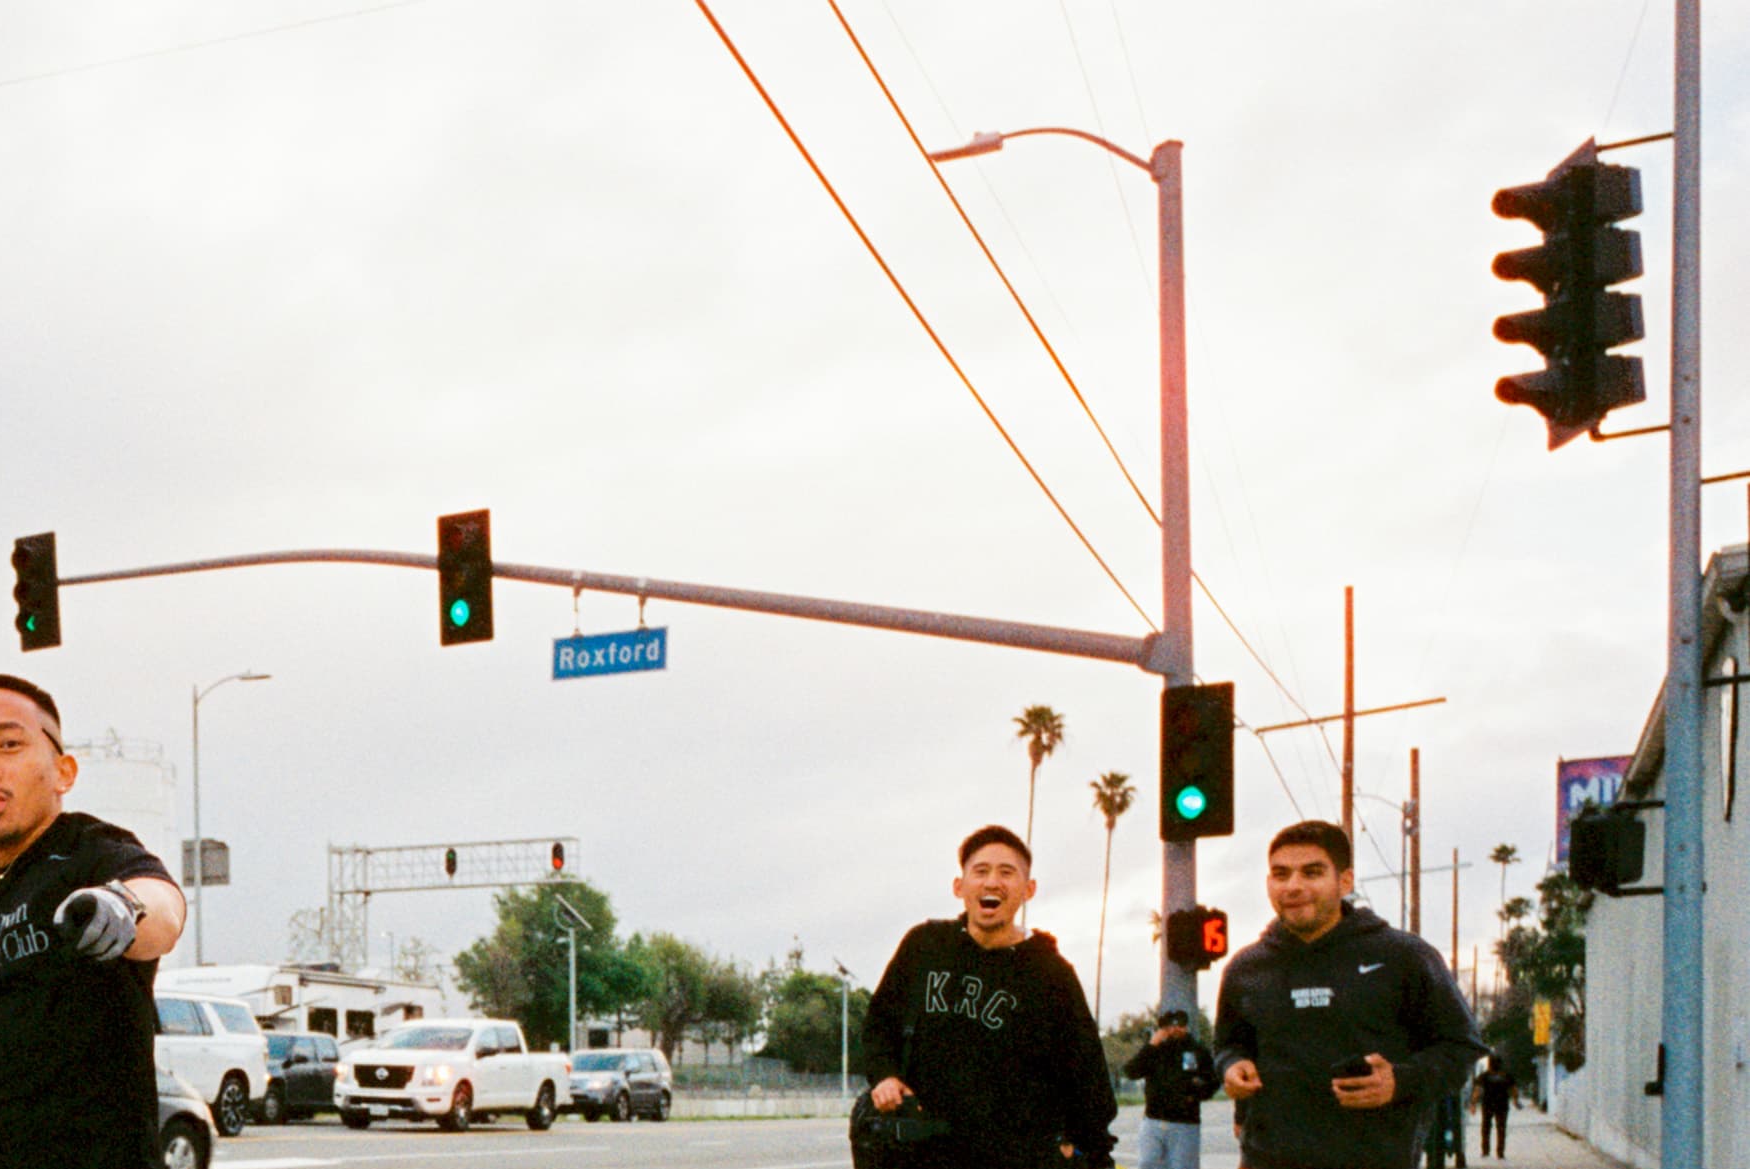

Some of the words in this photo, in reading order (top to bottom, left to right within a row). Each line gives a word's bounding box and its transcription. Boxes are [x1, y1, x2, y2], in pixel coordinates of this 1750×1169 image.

[559, 638, 660, 671] Roxford
[2, 923, 49, 962] Club
[925, 970, 1018, 1030] KRC
